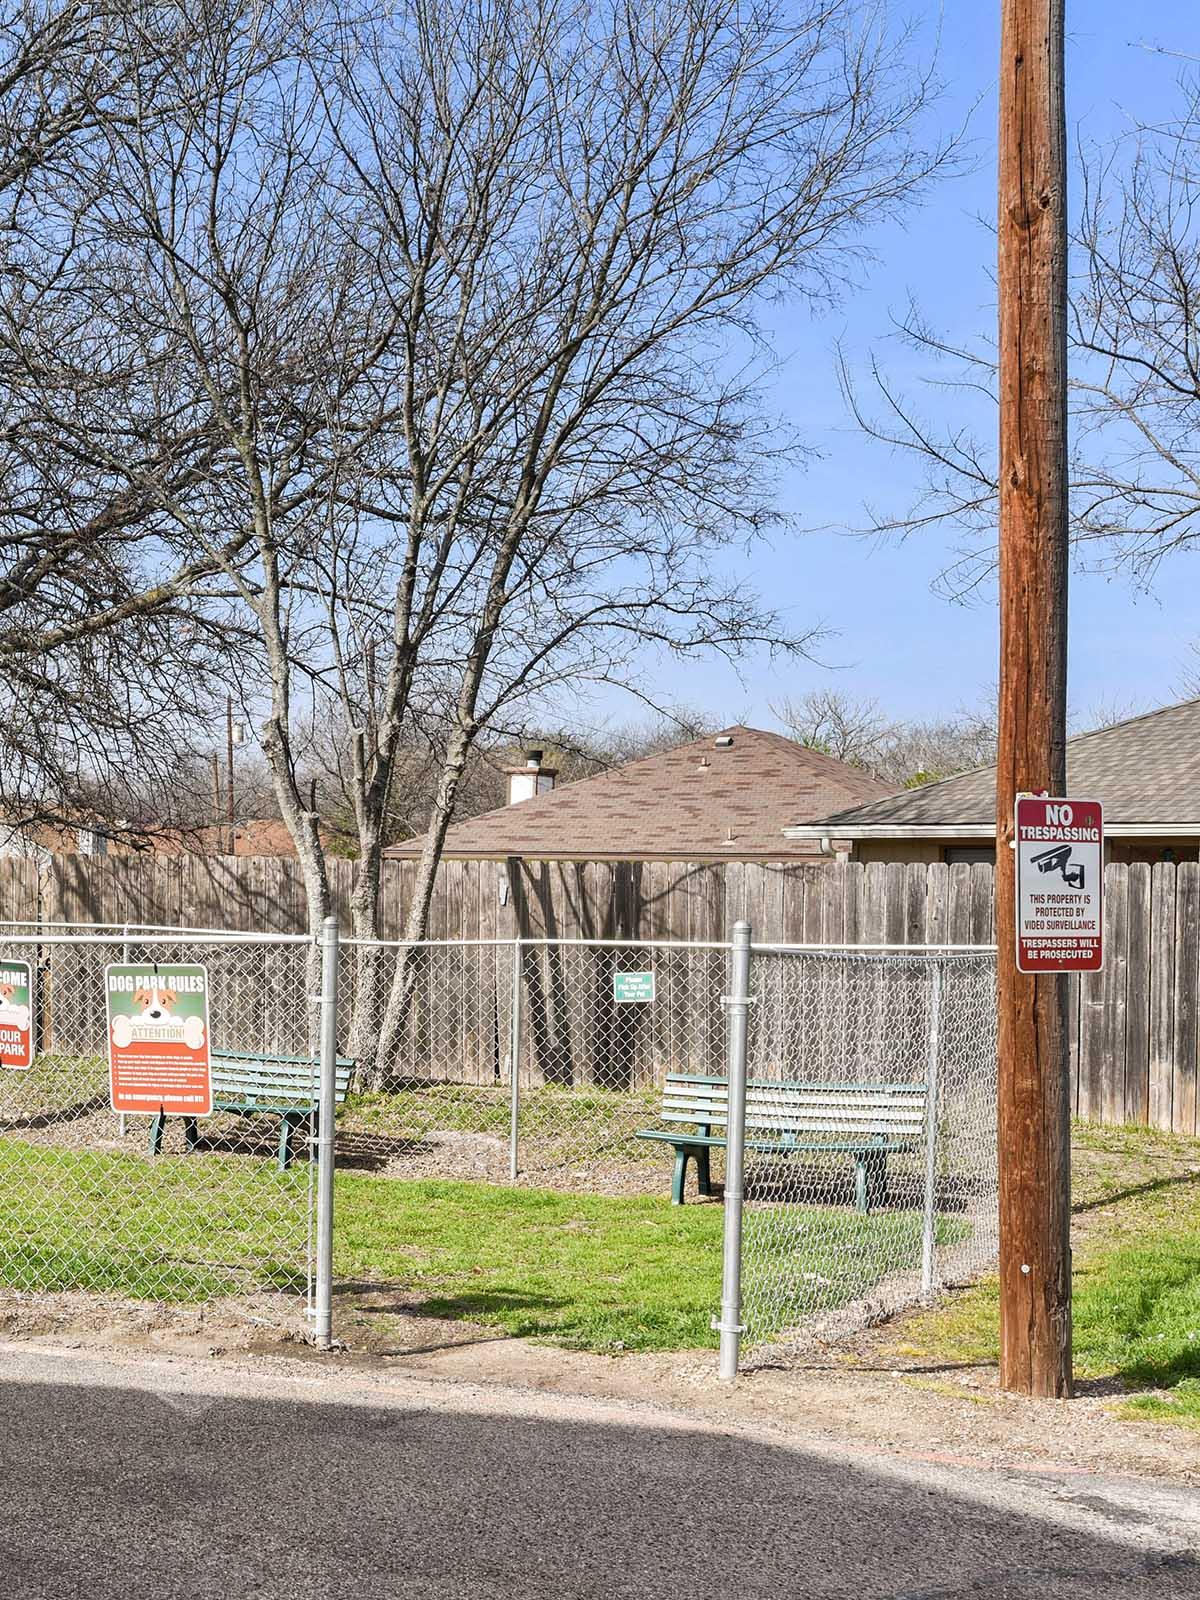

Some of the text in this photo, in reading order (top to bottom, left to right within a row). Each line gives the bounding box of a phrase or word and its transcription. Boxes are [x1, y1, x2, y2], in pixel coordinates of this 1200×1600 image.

[1045, 804, 1073, 826] NO
[1020, 826, 1099, 841] TRESPASSING
[1030, 894, 1091, 904] THIS PROPERTY IS
[1035, 907, 1085, 917] PROTECTED BY
[1024, 920, 1096, 930] VIDEO SURVEILLANCE
[1021, 939, 1099, 948] TRESPASSERS WILL
[1027, 950, 1093, 959] BE PROSECUTED
[109, 975, 204, 992] DOG PARK RULES
[132, 1027, 185, 1040] ATTENTION!
